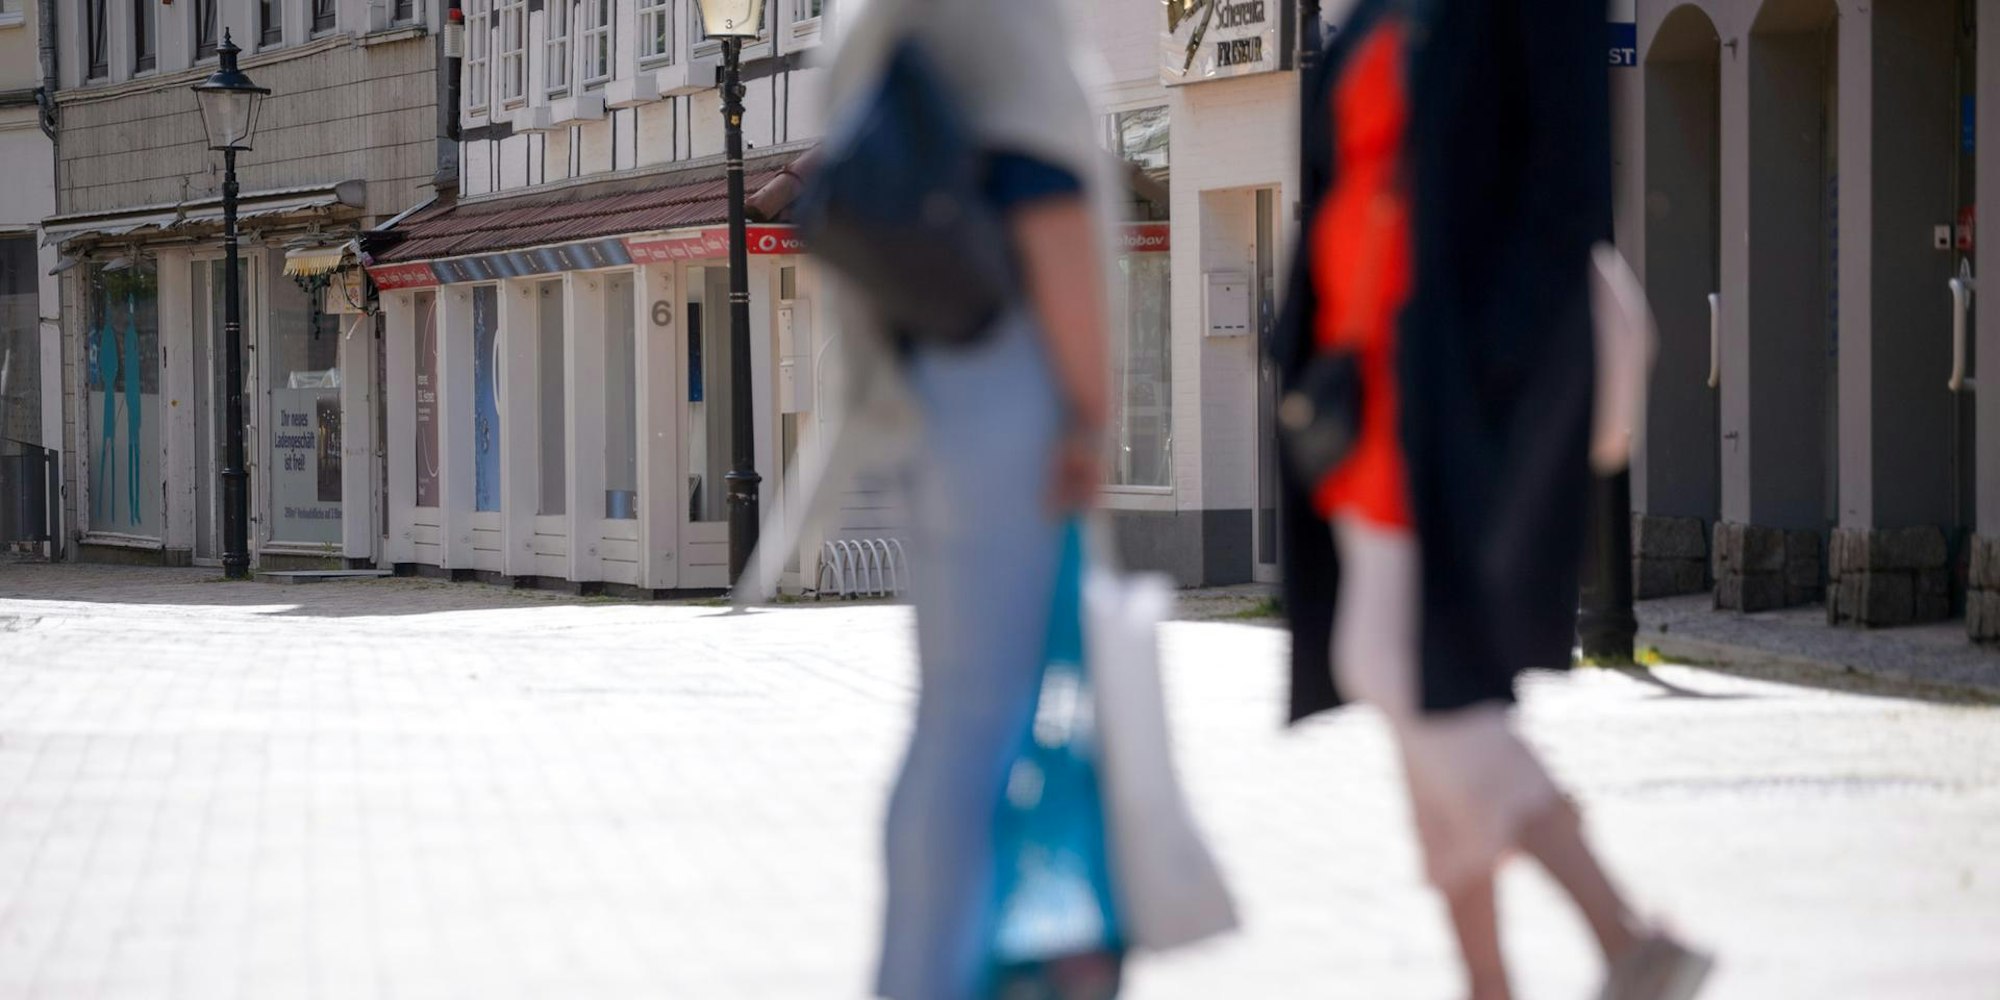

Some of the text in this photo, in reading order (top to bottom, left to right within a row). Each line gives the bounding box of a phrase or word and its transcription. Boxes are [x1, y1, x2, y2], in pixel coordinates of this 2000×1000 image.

[725, 19, 733, 29] 3
[651, 300, 672, 326] 6
[281, 410, 308, 426] Ihr neues
[284, 453, 292, 470] ist
